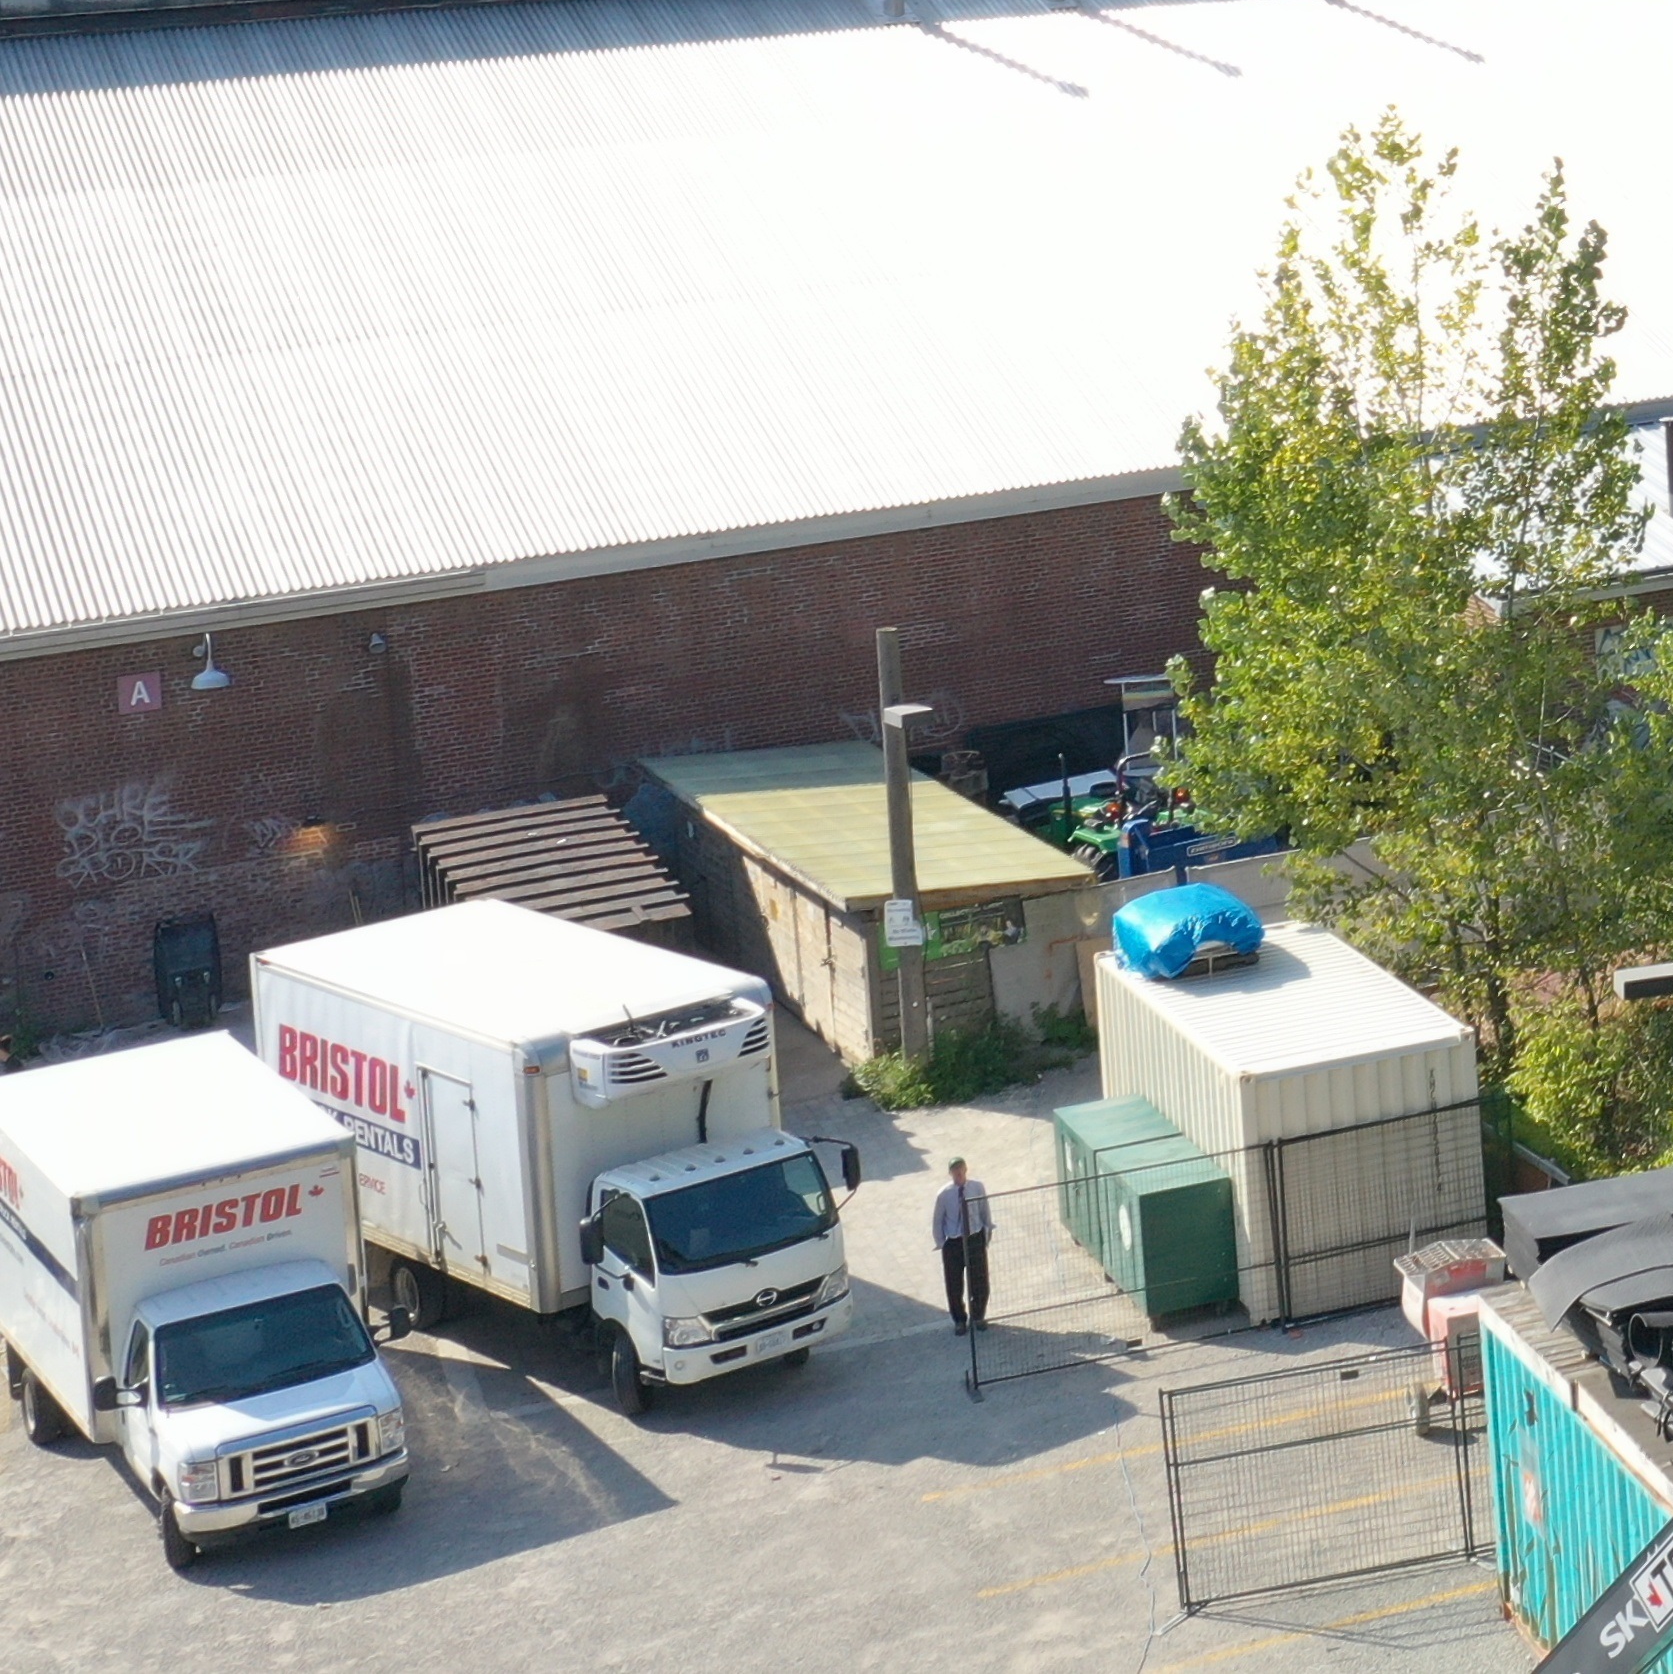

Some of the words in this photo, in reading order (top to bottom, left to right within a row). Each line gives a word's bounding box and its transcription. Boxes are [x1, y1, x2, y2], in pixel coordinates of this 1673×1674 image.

[130, 680, 151, 706] A
[671, 1028, 727, 1049] KINGTEC
[278, 1022, 406, 1124] BRISTOL
[143, 1182, 302, 1252] BRISTOL
[1599, 1596, 1650, 1659] SK
